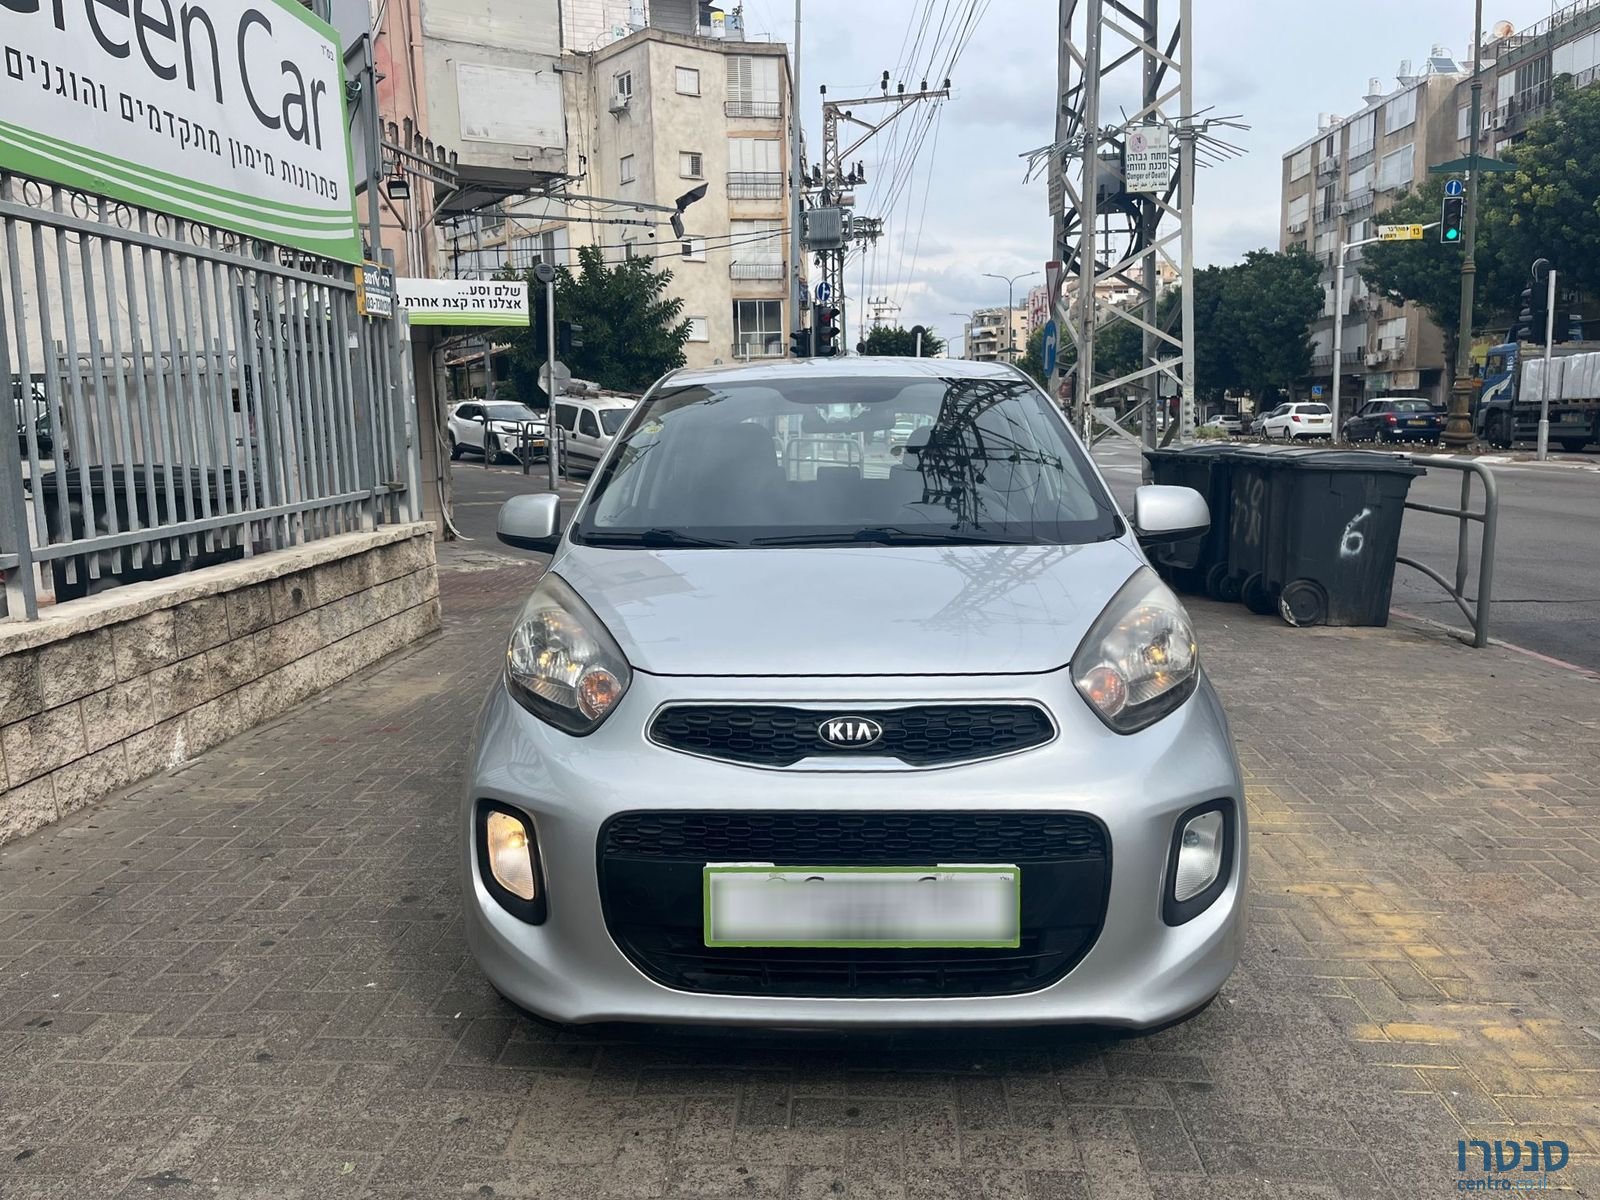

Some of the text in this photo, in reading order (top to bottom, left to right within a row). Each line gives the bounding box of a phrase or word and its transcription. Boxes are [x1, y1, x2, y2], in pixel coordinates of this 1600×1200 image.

[0, 0, 326, 151] een Car
[5, 46, 338, 201] פתרונות מימון מתקדמים והוגנים
[1149, 162, 1167, 170] סכנת
[457, 284, 521, 296] שלם וסע...
[404, 297, 439, 307] אחרת
[442, 298, 468, 310] קצת
[472, 299, 485, 308] זה
[489, 297, 522, 309] אצלנו
[1340, 508, 1371, 558] 6
[828, 722, 873, 741] KIA
